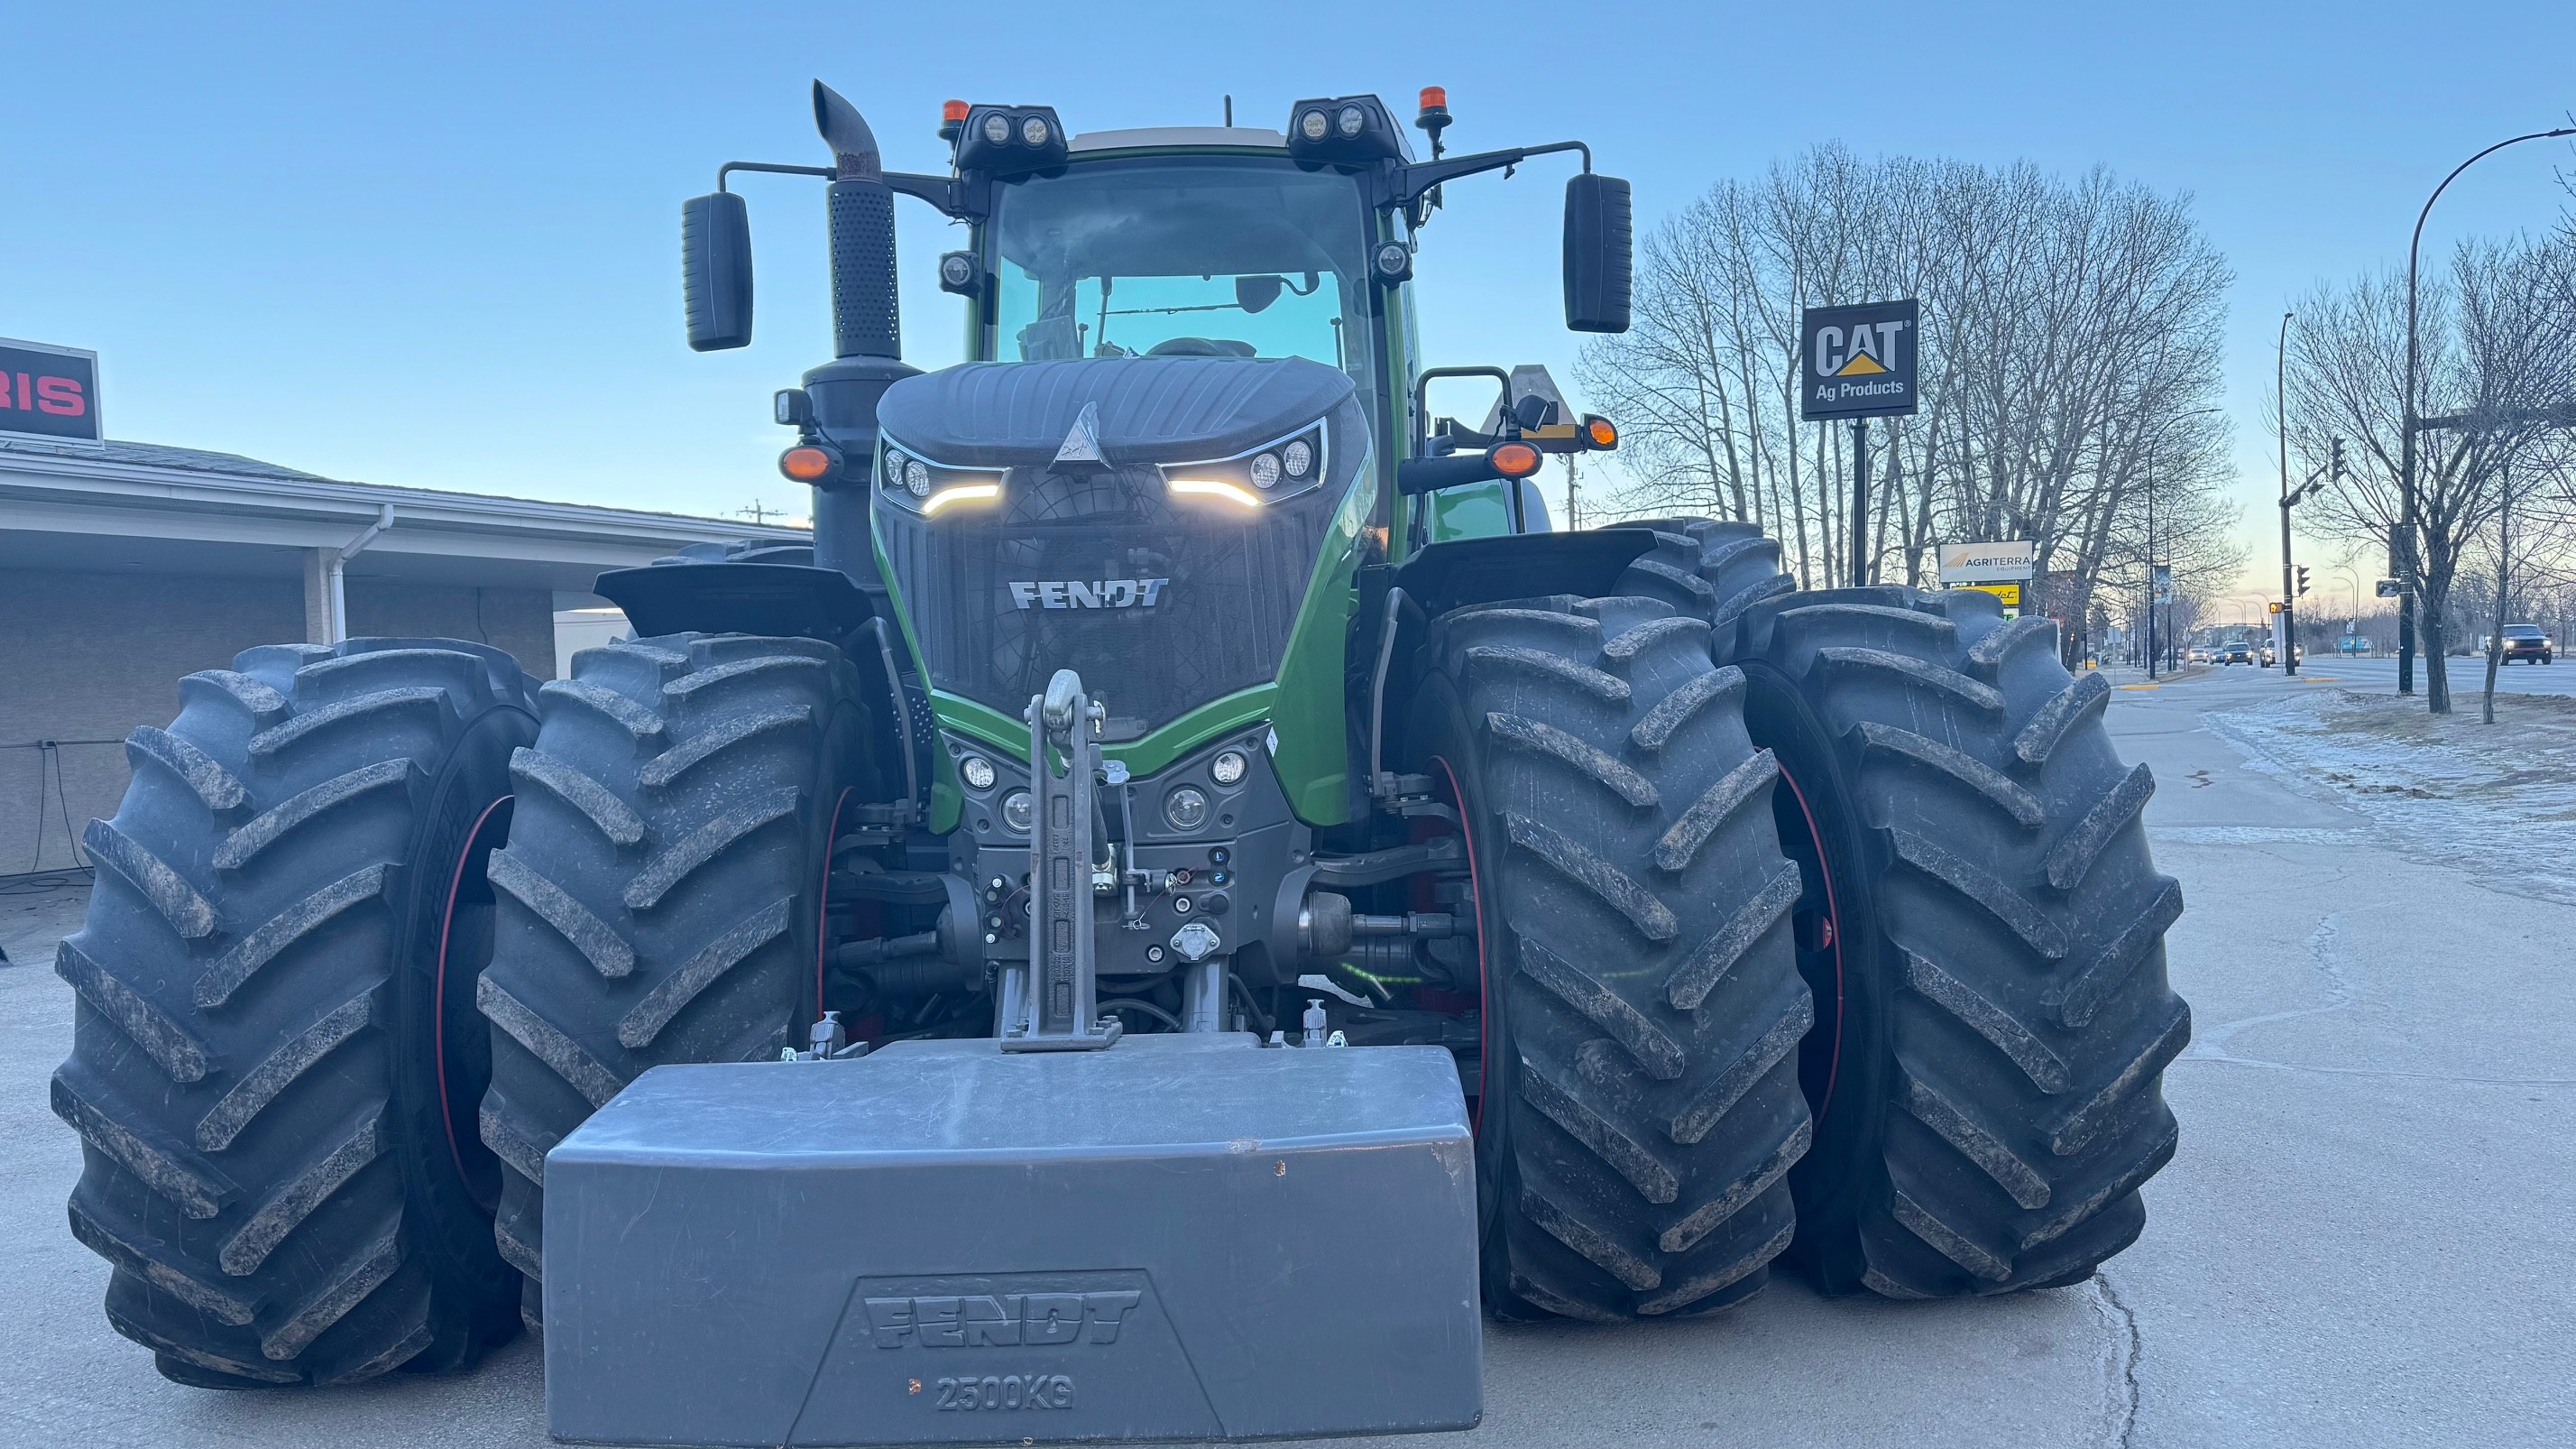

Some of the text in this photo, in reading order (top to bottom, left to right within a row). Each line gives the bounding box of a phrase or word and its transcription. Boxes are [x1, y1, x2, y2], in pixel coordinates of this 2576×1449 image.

[1816, 320, 1903, 377] CAT
[0, 370, 85, 416] IS
[1816, 381, 1904, 401] Ag Products
[1965, 556, 2030, 568] AGRITERRA
[1008, 578, 1169, 609] FENDT
[864, 1290, 1142, 1349] FENDT
[935, 1372, 1075, 1410] 2500KG
